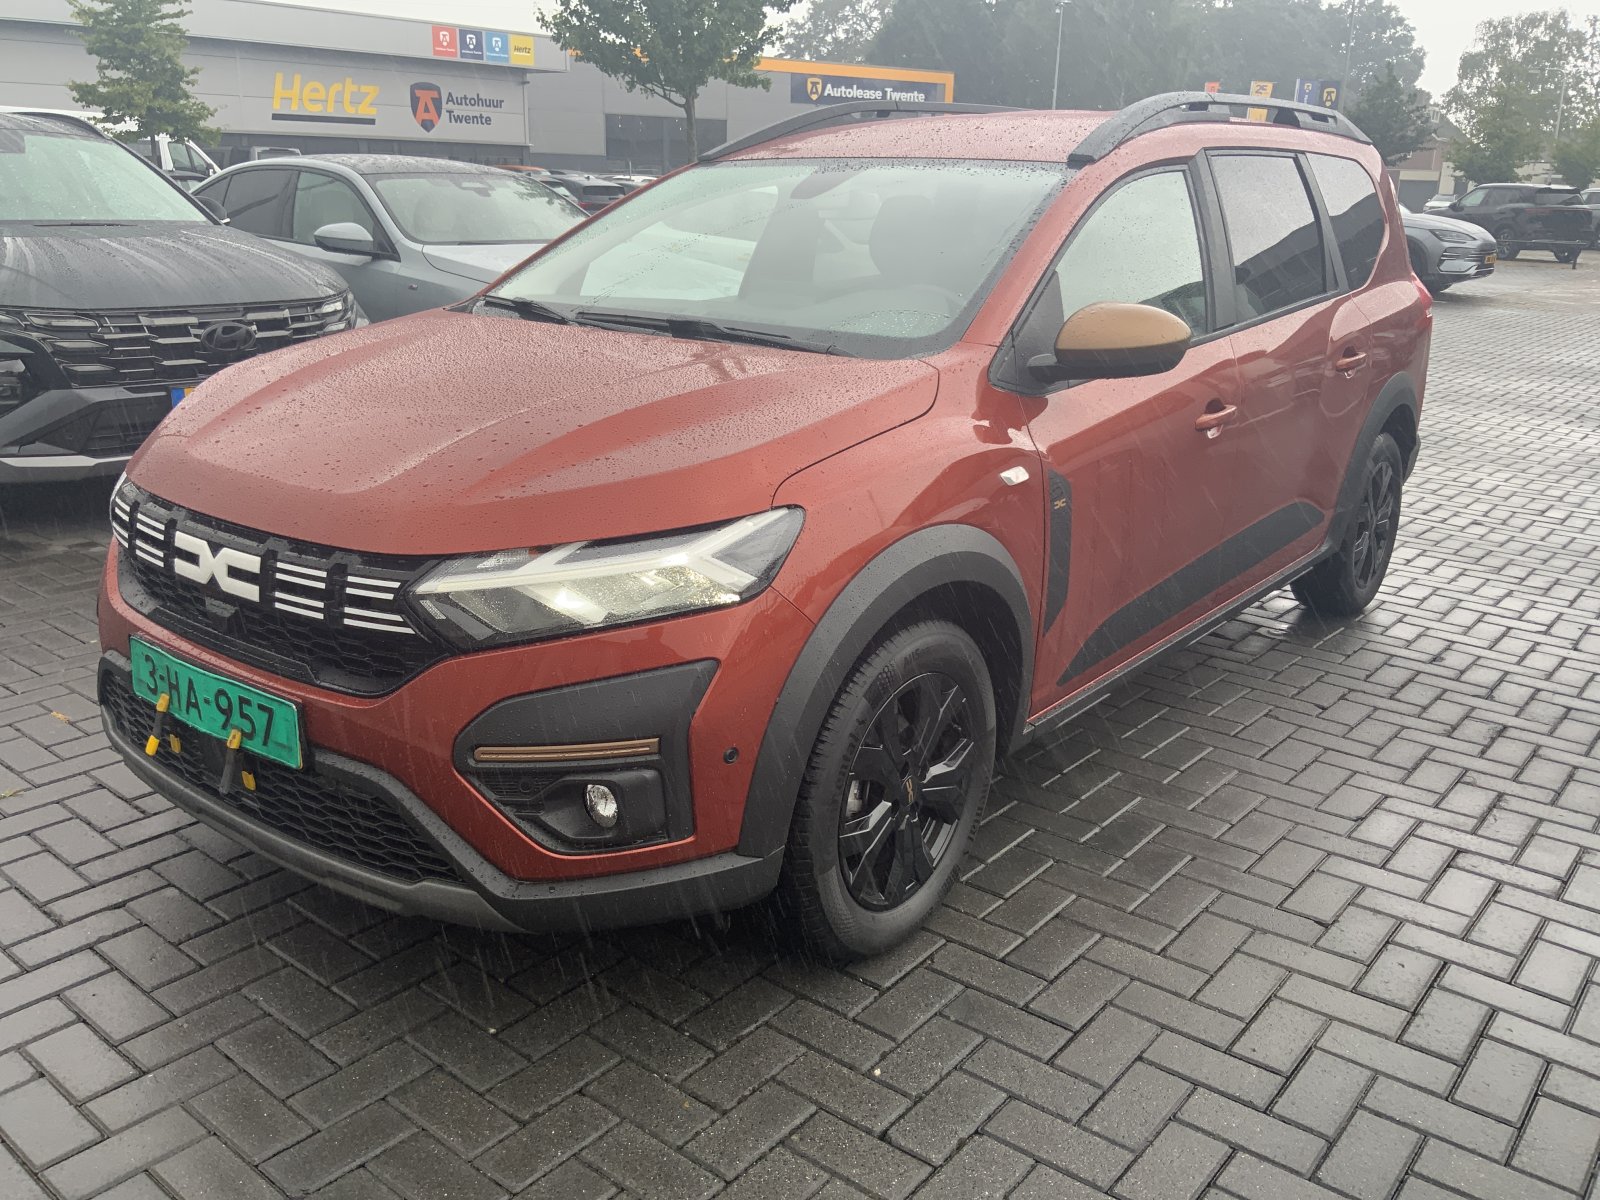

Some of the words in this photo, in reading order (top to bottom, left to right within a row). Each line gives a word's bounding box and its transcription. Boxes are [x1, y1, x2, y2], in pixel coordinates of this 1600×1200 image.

[513, 45, 532, 54] Hertz
[272, 72, 379, 115] Hertz
[445, 91, 505, 109] Autohuur
[824, 83, 882, 99] Autolease
[885, 88, 925, 102] Twente
[446, 110, 492, 126] Twente
[144, 654, 275, 747] 3-HA-957
